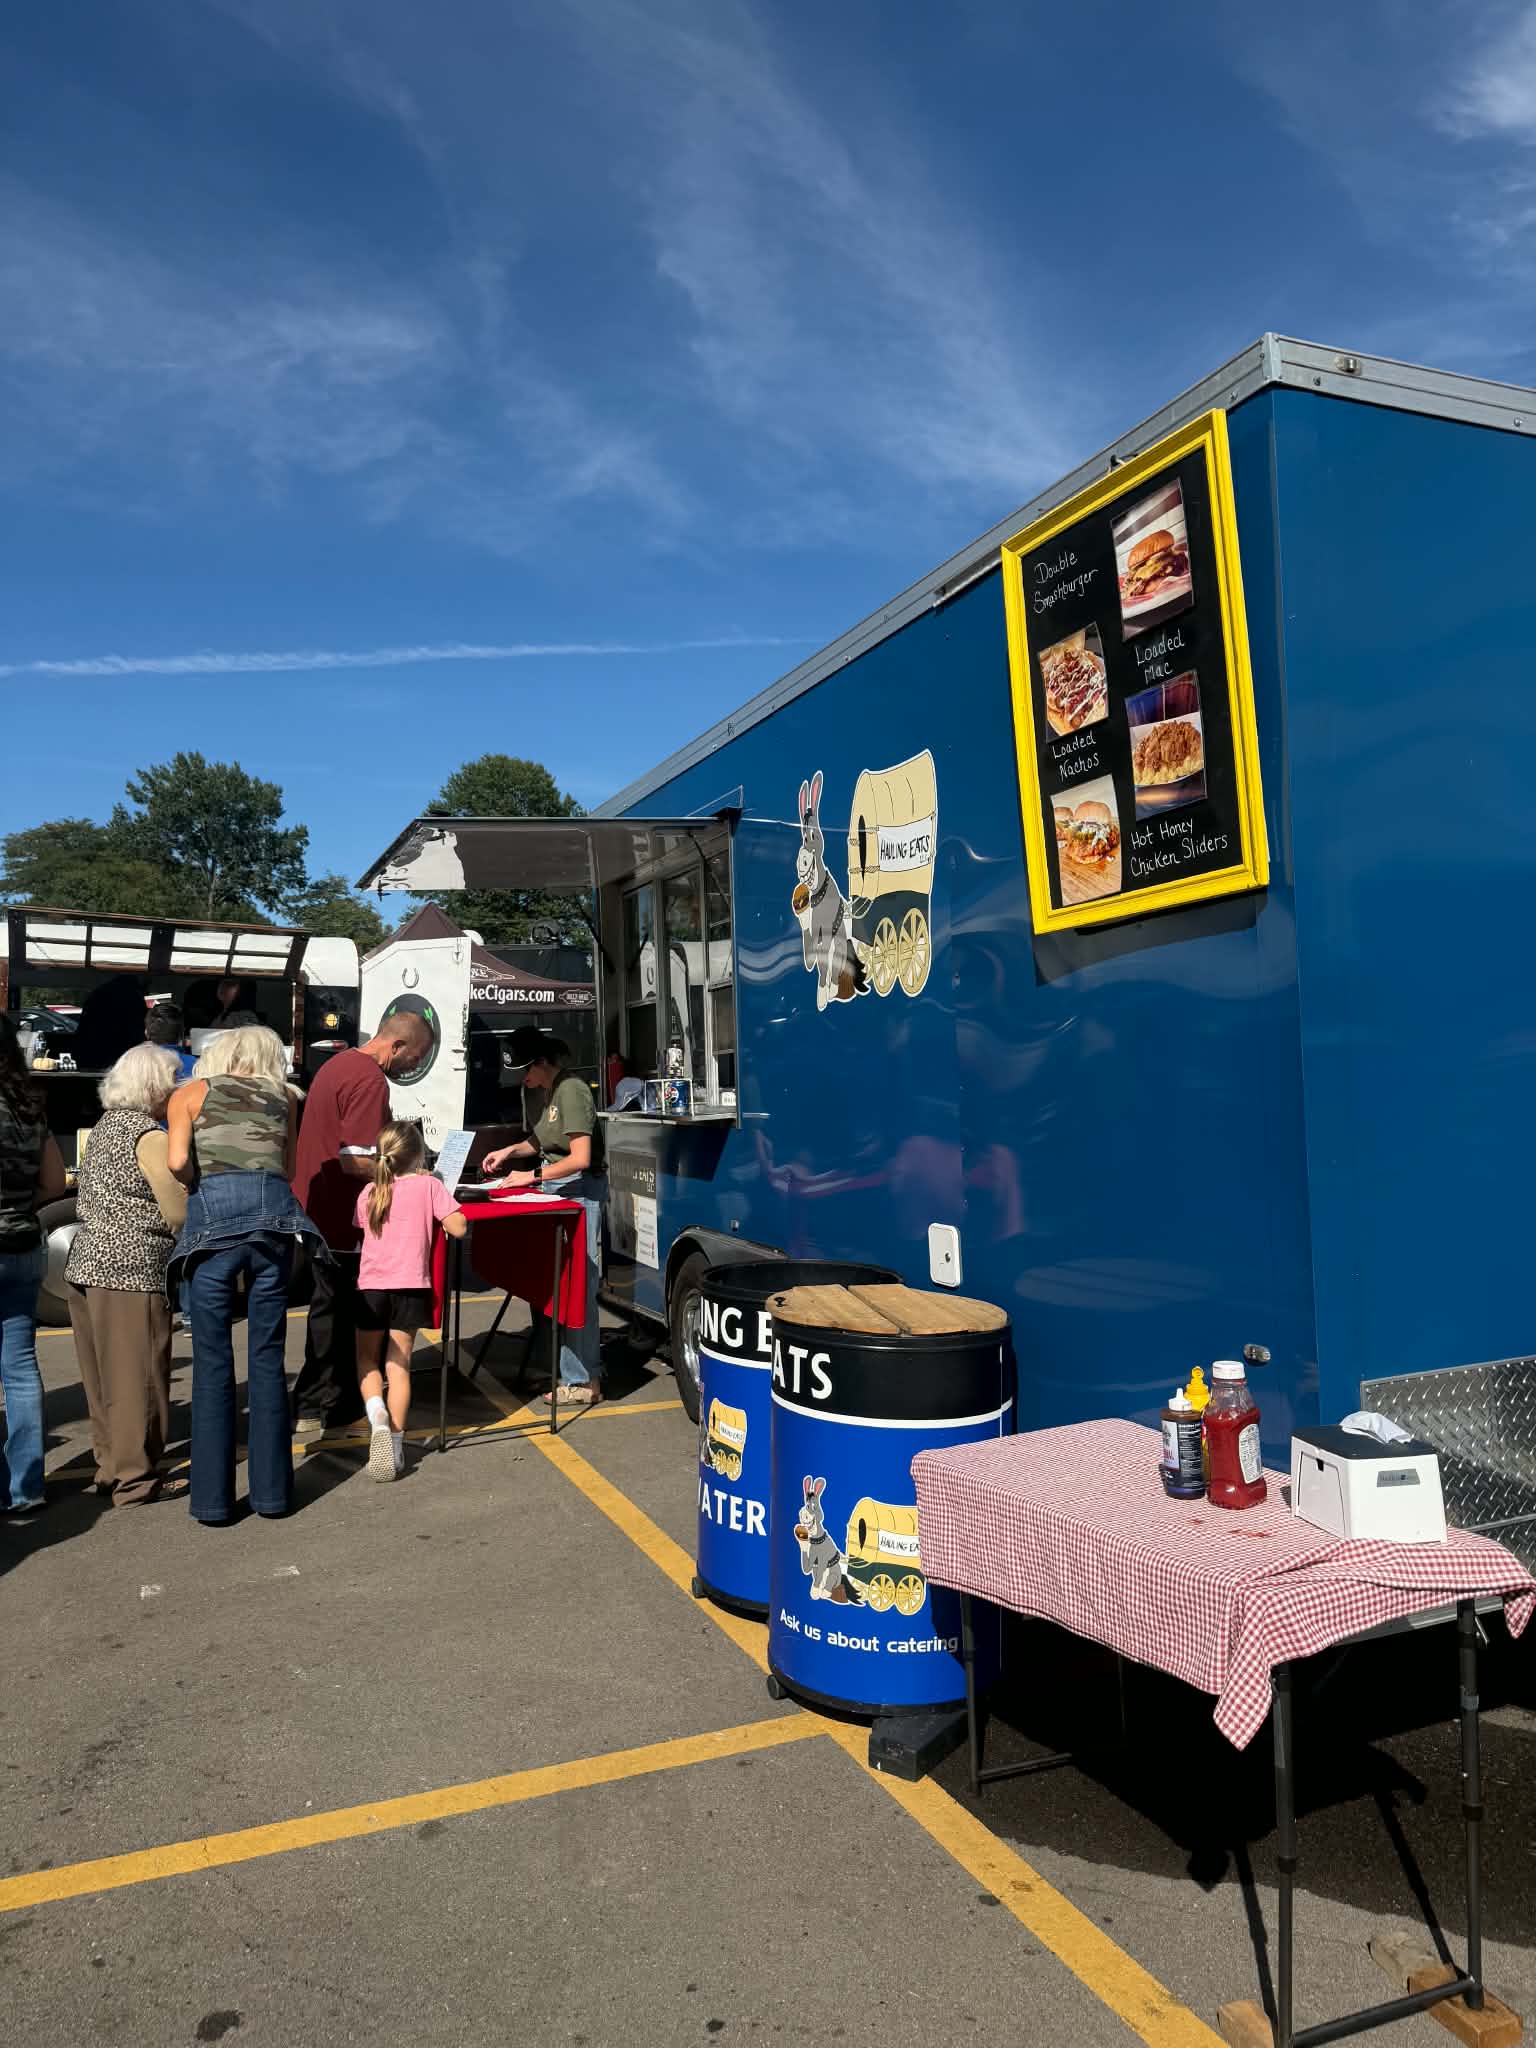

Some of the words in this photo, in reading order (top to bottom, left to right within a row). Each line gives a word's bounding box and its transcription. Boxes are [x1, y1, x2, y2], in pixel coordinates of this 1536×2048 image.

[1034, 552, 1078, 584] Double
[1033, 569, 1099, 614] Smashburger
[1135, 628, 1185, 667] Loaded
[1144, 662, 1173, 685] Mac
[1052, 730, 1097, 759] Loaded
[1059, 752, 1100, 782] Nachos
[880, 839, 907, 861] HAULING
[909, 834, 930, 858] EATS
[1130, 824, 1154, 850] Hot
[1159, 818, 1193, 840] Honey
[1130, 850, 1181, 877] Chicken
[1181, 833, 1228, 859] Sliders
[470, 983, 555, 1005] keCigars.com
[698, 1476, 767, 1537] ATER
[780, 1608, 800, 1633] Ask
[804, 1623, 821, 1641] us
[827, 1631, 880, 1652] about
[886, 1636, 959, 1653] catering
